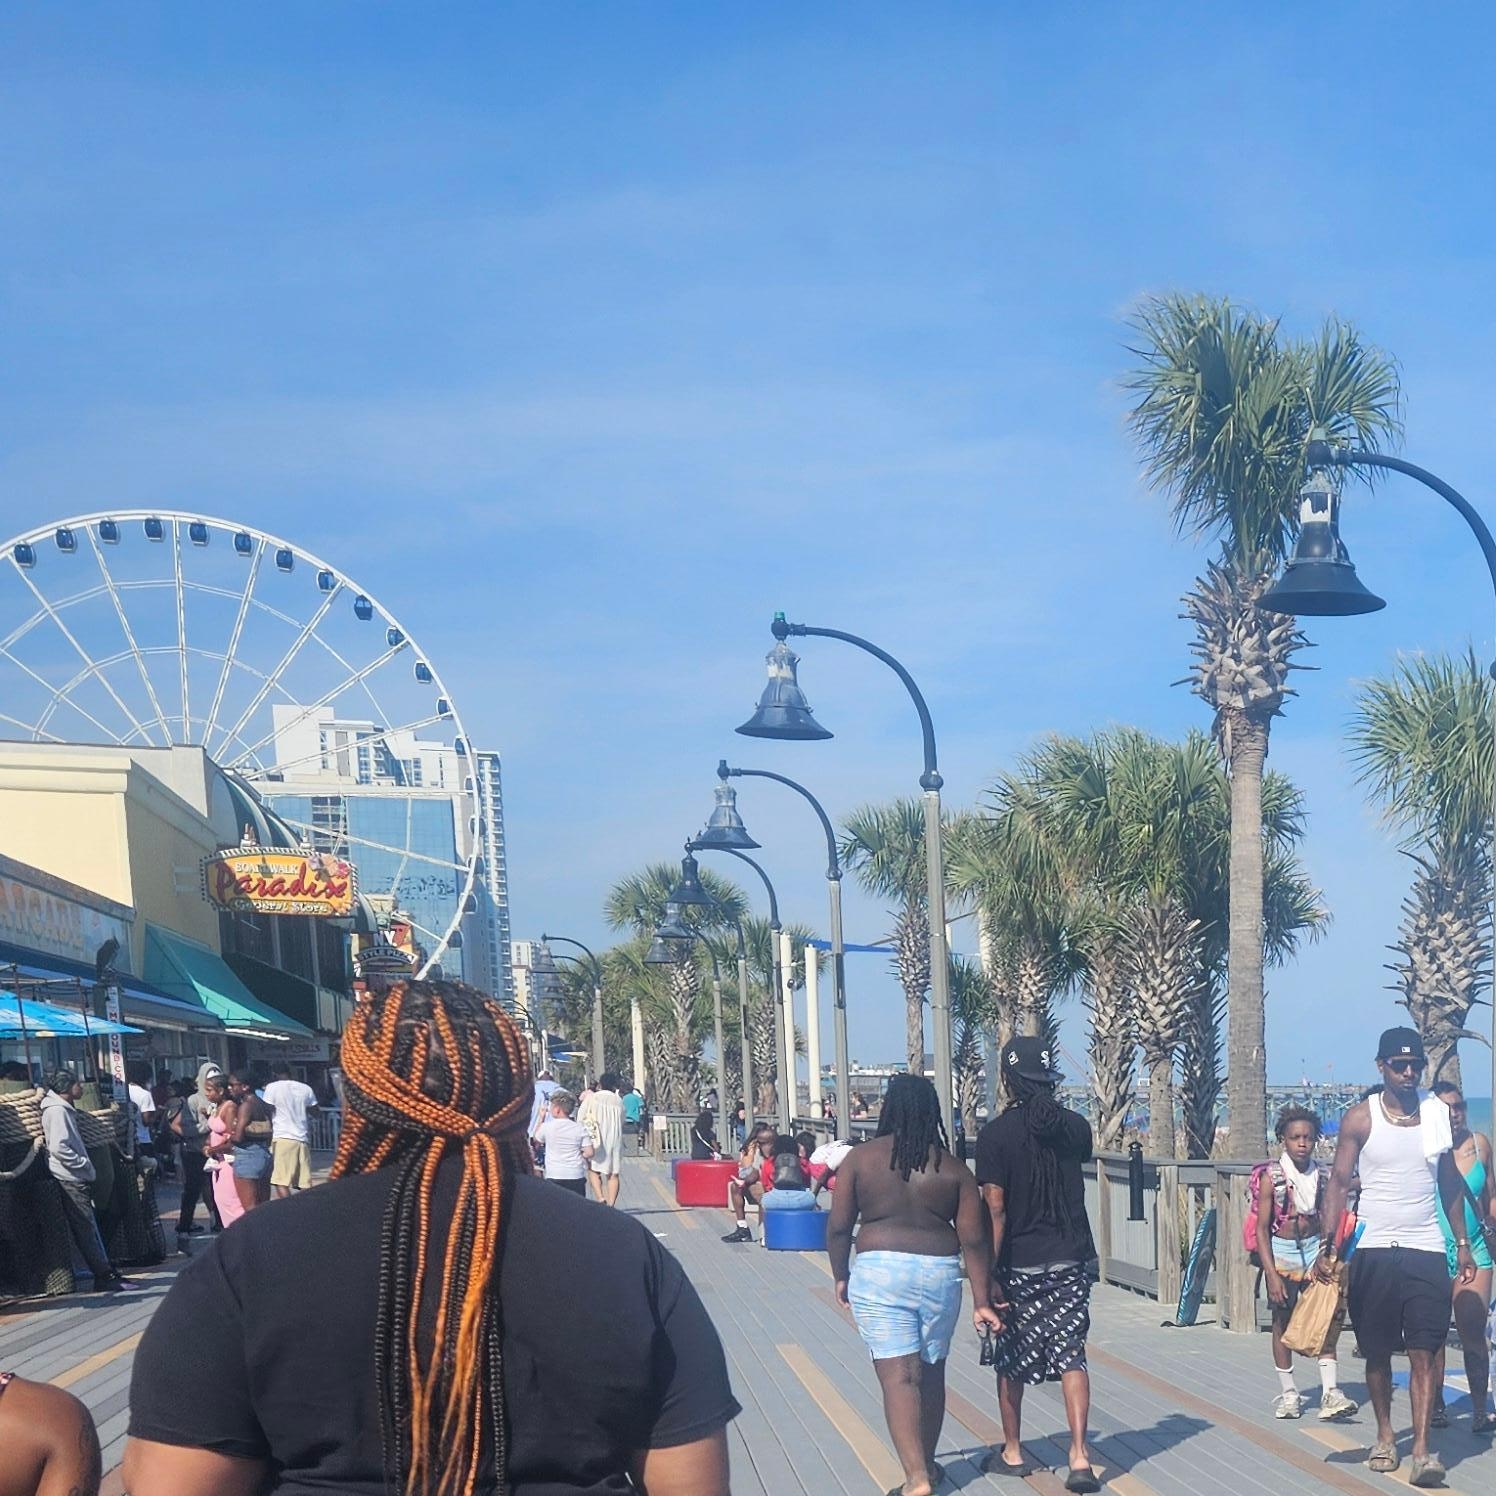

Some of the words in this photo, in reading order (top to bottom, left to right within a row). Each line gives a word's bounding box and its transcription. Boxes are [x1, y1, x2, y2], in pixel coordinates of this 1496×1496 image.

[235, 863, 298, 874] BOAWALK
[215, 861, 348, 903] Paradise
[291, 902, 328, 914] Store
